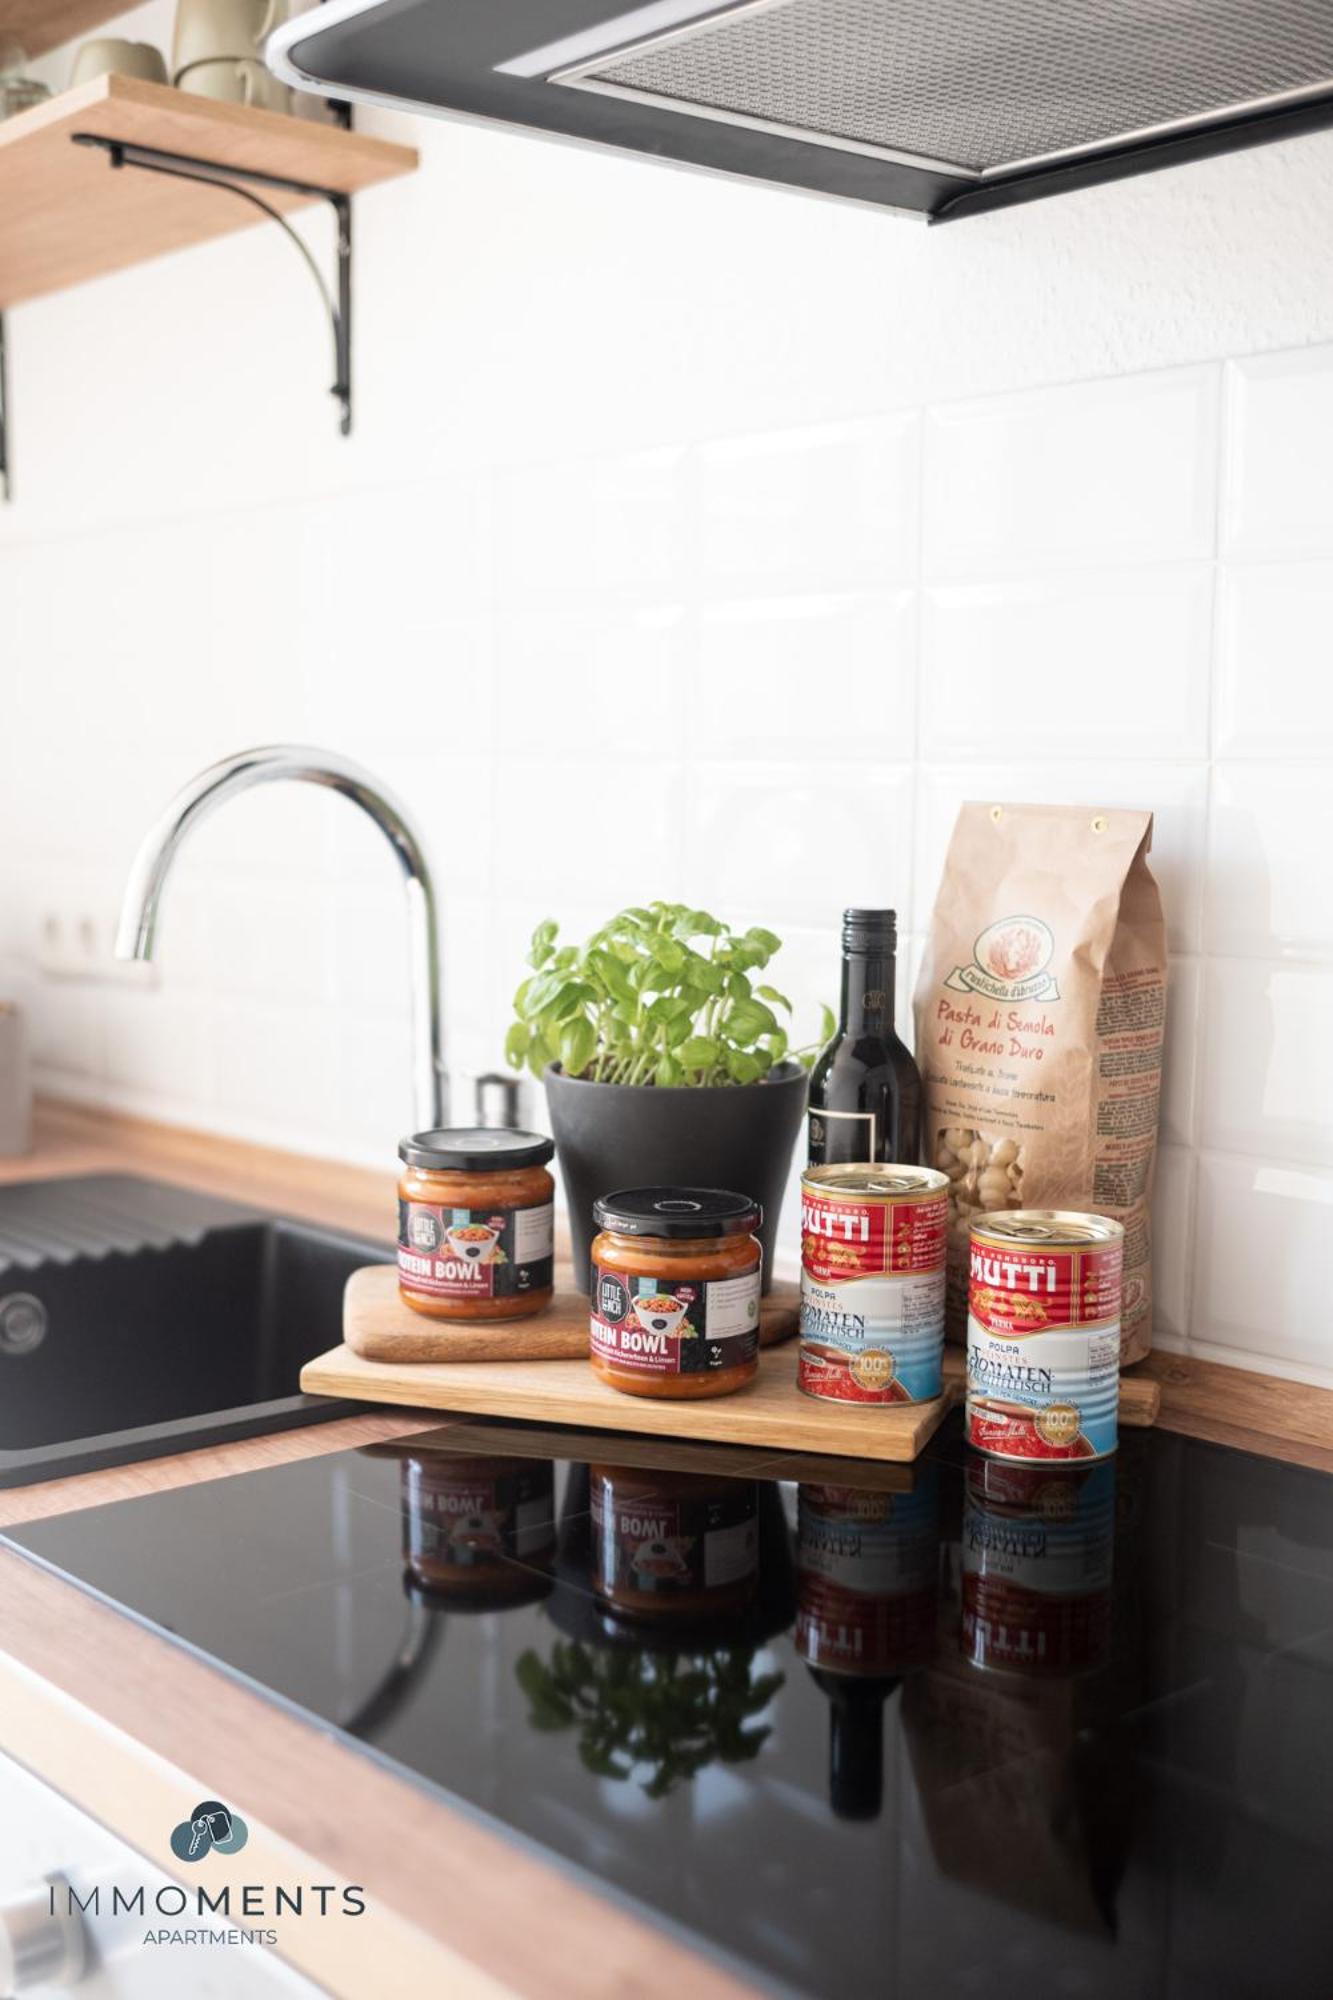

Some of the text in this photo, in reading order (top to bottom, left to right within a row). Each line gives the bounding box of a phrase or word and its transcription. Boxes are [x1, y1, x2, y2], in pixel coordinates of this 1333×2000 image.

[937, 999, 1055, 1036] Pasta di Semola
[938, 1028, 1044, 1061] di Grano Duro
[435, 1261, 482, 1281] BOWL
[970, 1253, 1056, 1292] MUTTI
[602, 1282, 621, 1302] LITTLE
[621, 1330, 668, 1355] BOWL
[988, 1342, 1020, 1354] POLPA
